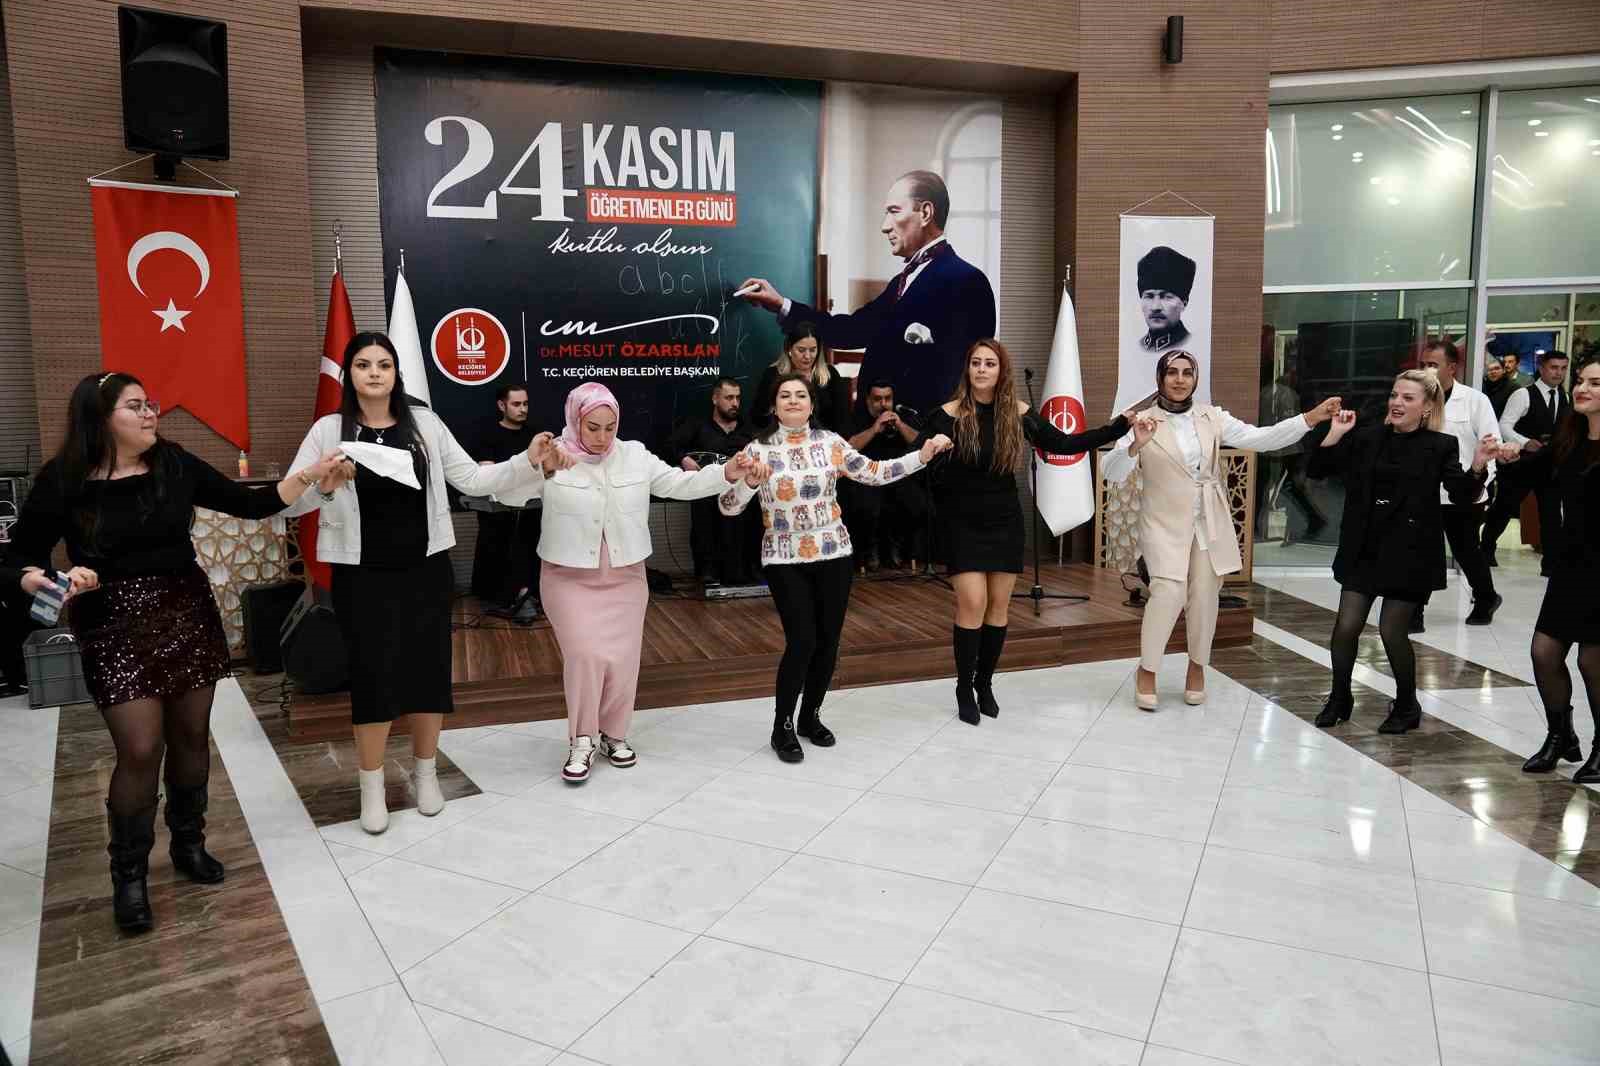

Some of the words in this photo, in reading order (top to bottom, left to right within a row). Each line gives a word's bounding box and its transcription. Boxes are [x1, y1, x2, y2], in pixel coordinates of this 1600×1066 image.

[424, 115, 579, 223] 24
[582, 121, 736, 192] KASIM
[590, 192, 695, 220] ÖĞRETMENLER
[695, 197, 734, 223] GÜNÜ
[547, 226, 626, 254] kutlu
[631, 228, 713, 257] olsun
[620, 341, 720, 358] ÖZARSLAN
[542, 367, 561, 378] T.C.
[562, 365, 618, 380] KEÇİÖREN
[620, 365, 673, 377] BELEDİYE
[673, 366, 720, 379] BAŞKANI
